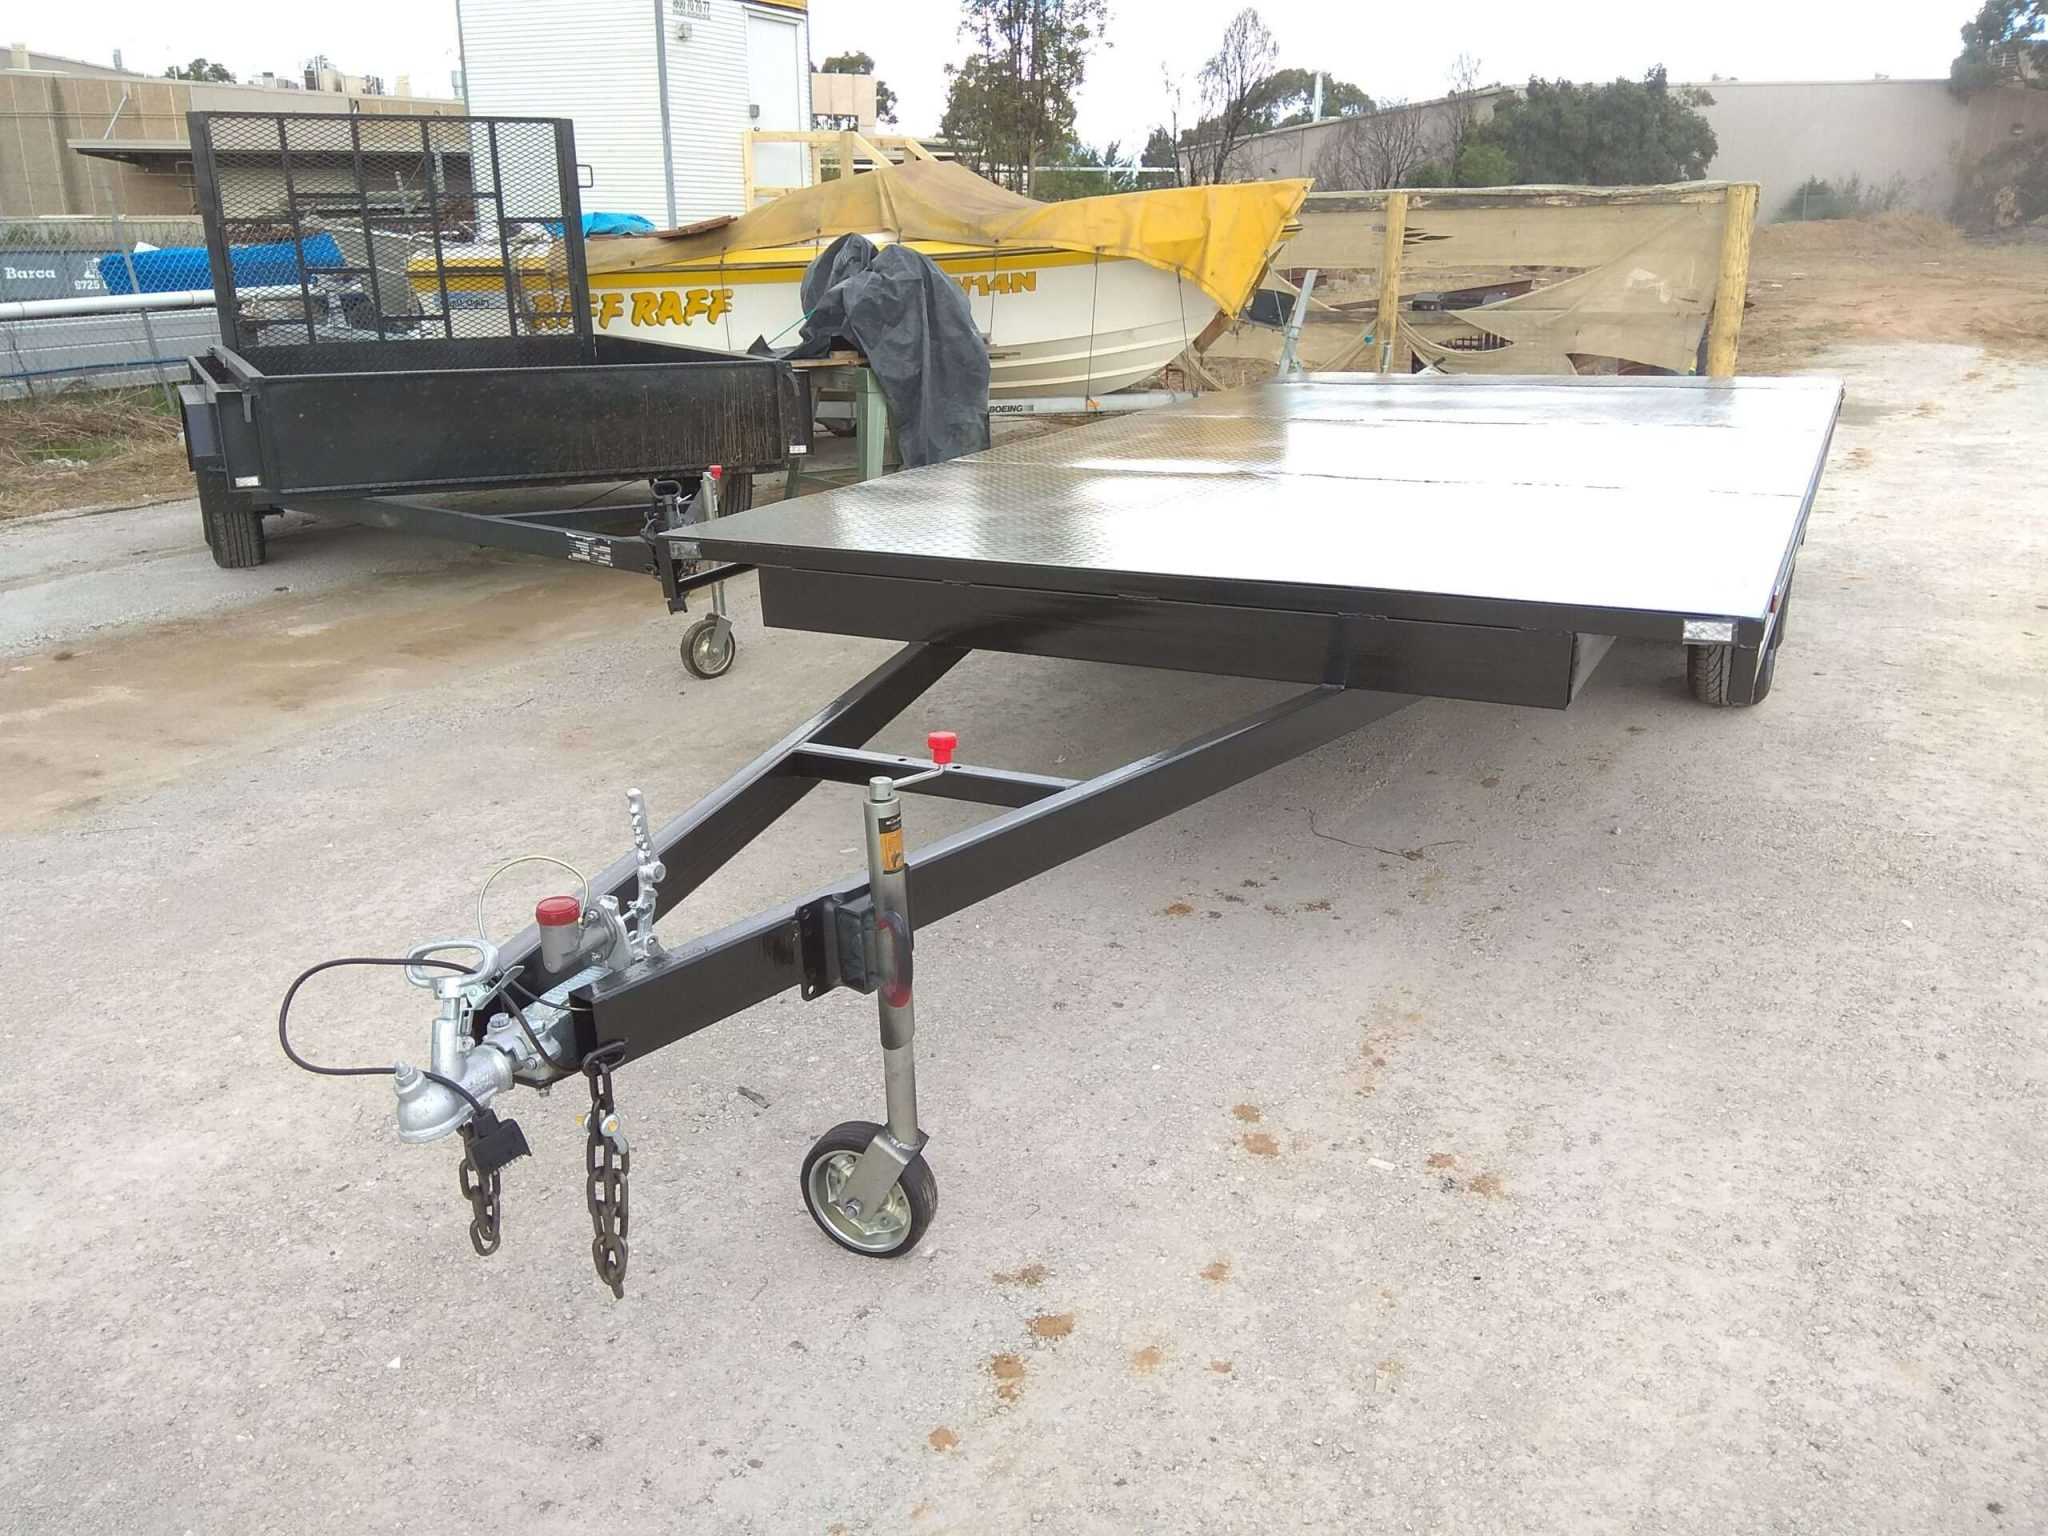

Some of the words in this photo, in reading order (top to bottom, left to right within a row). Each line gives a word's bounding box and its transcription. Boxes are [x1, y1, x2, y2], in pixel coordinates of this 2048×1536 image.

[4, 266, 56, 279] Barca
[631, 288, 733, 327] RAFF
[989, 404, 1023, 413] BOEING
